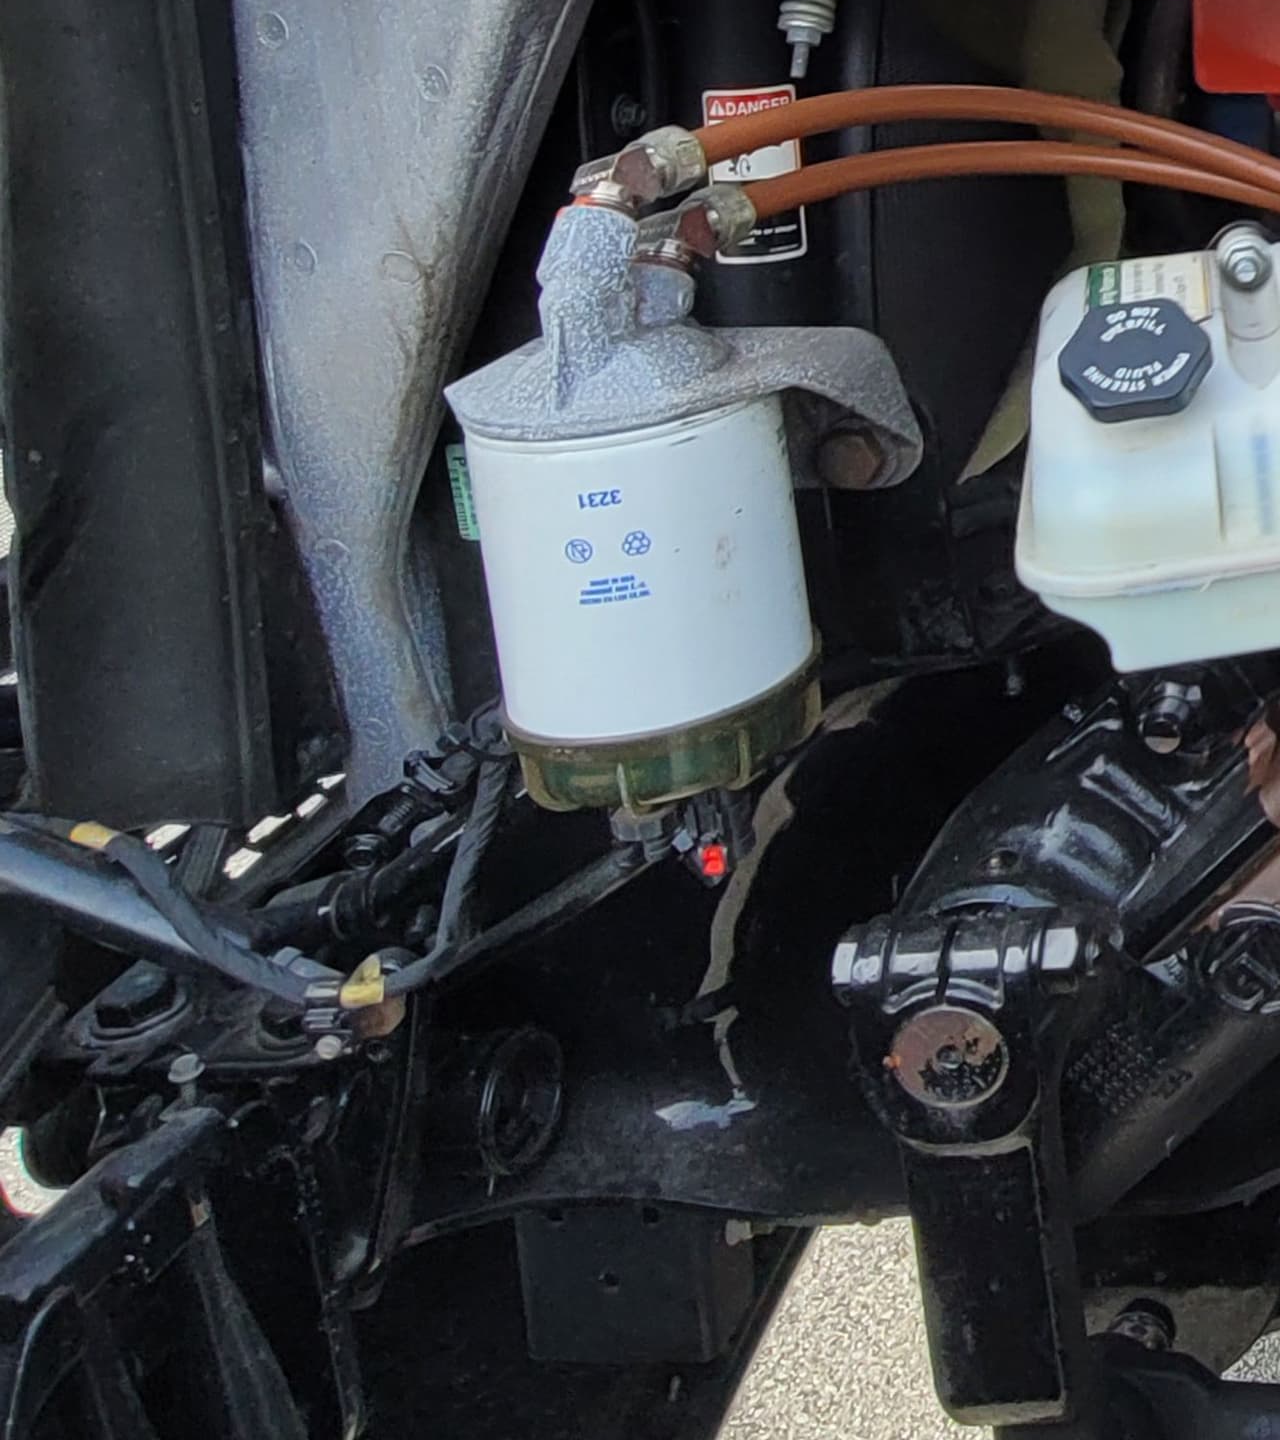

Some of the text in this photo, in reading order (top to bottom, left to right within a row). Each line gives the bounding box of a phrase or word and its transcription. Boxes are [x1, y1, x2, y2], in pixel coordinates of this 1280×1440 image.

[725, 96, 790, 117] DANGER
[1105, 307, 1160, 325] DO NOT
[1101, 318, 1166, 342] OVERFILL
[1082, 352, 1191, 393] POWER STEERING
[1114, 360, 1164, 379] FLUID
[578, 489, 622, 510] 3231
